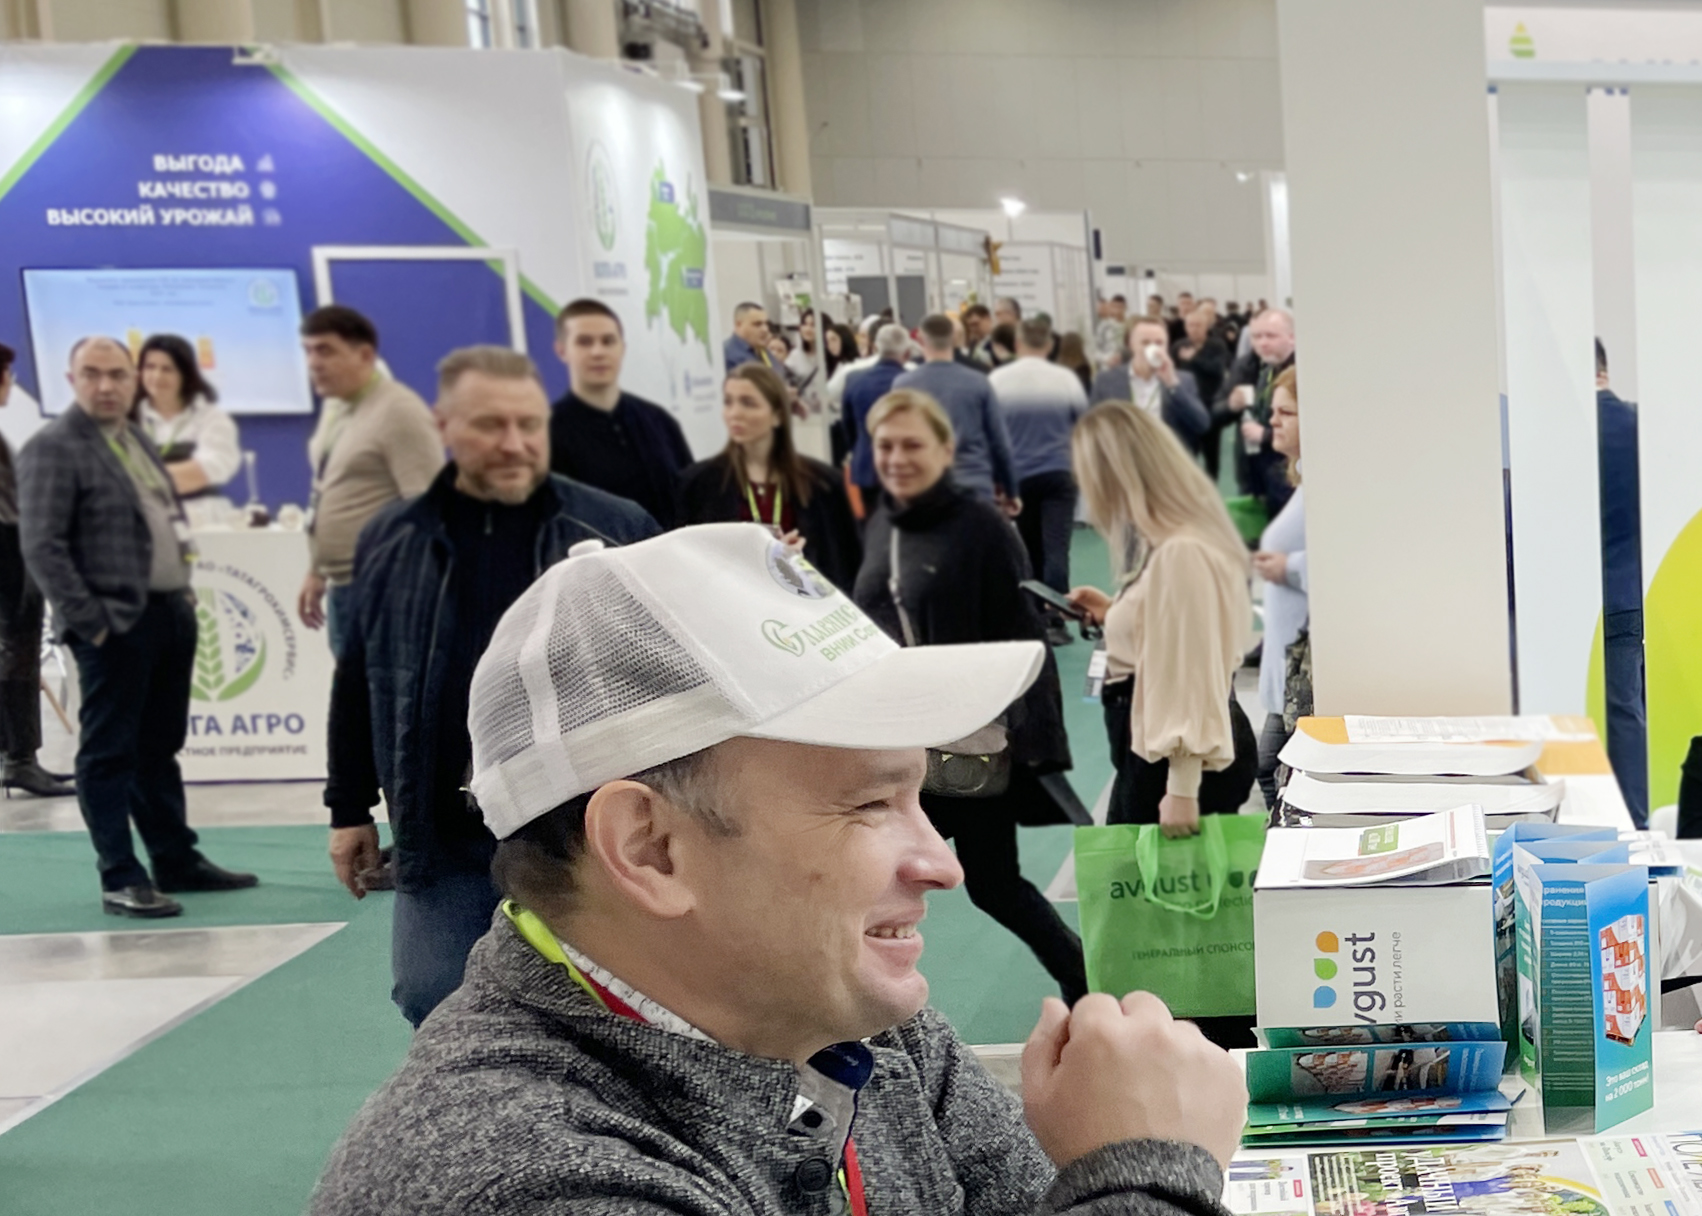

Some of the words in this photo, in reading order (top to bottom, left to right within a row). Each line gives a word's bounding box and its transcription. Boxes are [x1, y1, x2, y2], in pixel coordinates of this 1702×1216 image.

[153, 153, 244, 174] ВЫГОДА
[137, 180, 250, 199] КАЧЕСТВО
[46, 203, 155, 226] ВЫСОКИЙ
[159, 203, 255, 226] УРОЖАЙ
[231, 713, 305, 736] АГРО
[1110, 869, 1201, 903] avust
[1132, 946, 1204, 961] ГЕНЕРАЛЬНЫЙ
[1391, 931, 1402, 969] легче
[1393, 970, 1406, 1008] расти
[1605, 1075, 1618, 1087] Это
[1364, 1152, 1404, 1191] проект
